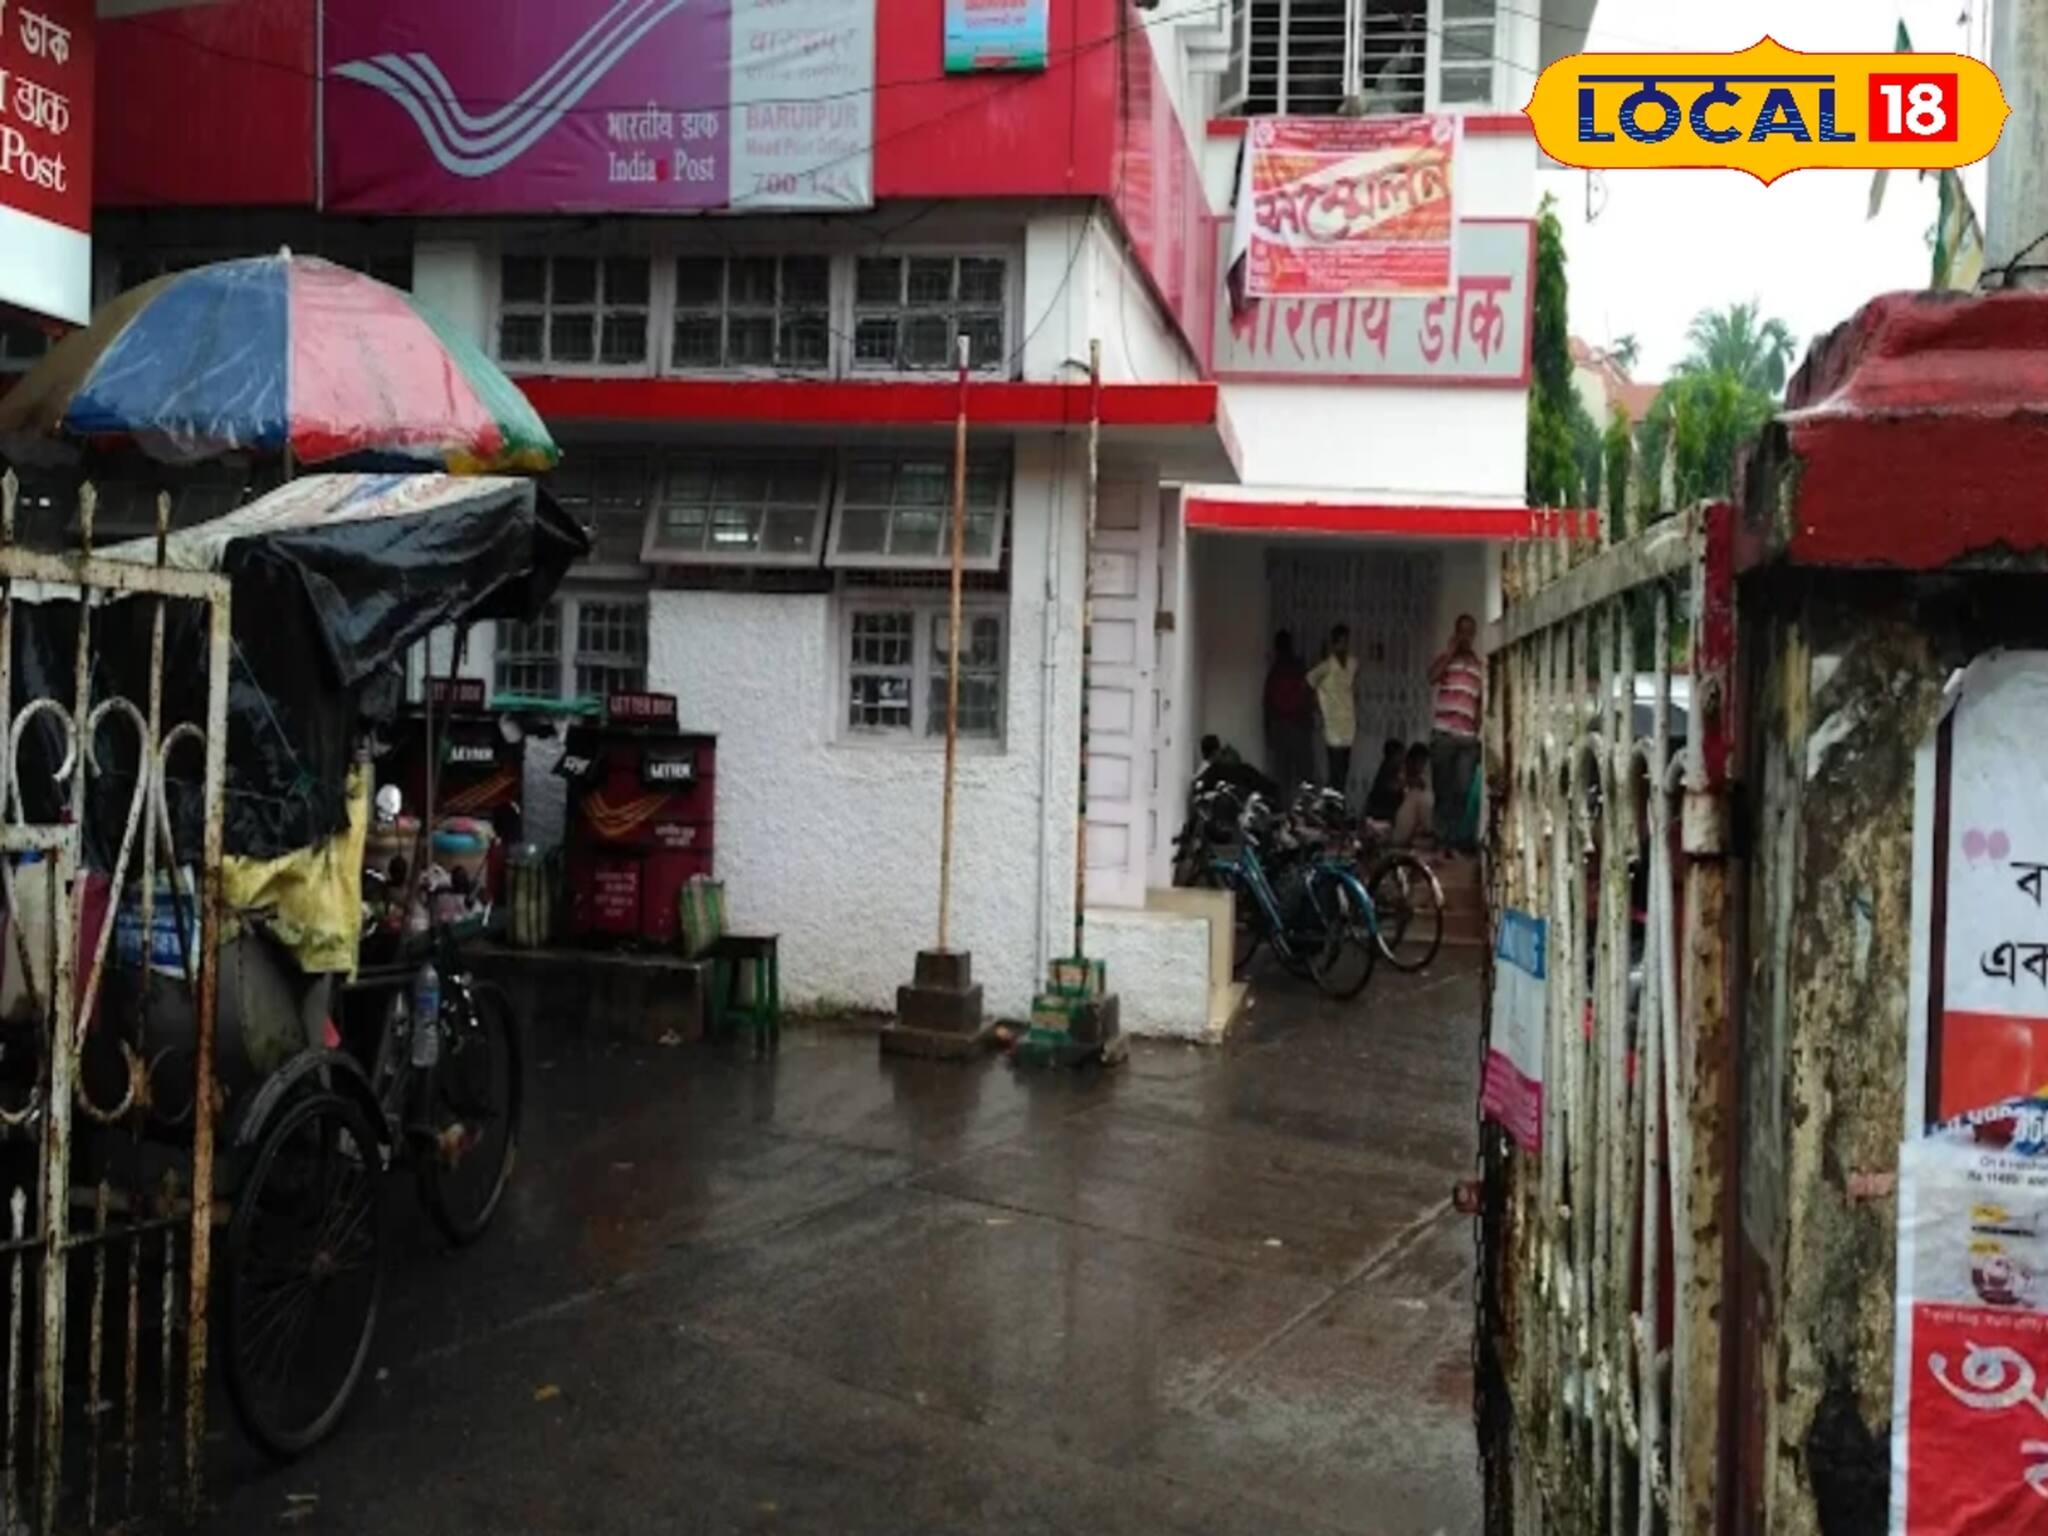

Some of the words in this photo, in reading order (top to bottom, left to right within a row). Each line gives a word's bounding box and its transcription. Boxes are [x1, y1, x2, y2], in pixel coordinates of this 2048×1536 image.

[18, 6, 72, 66] ডাক
[13, 76, 71, 136] डाक
[680, 111, 720, 139] डाक
[0, 124, 67, 192] Post
[608, 149, 657, 181] India
[673, 147, 715, 181] Post
